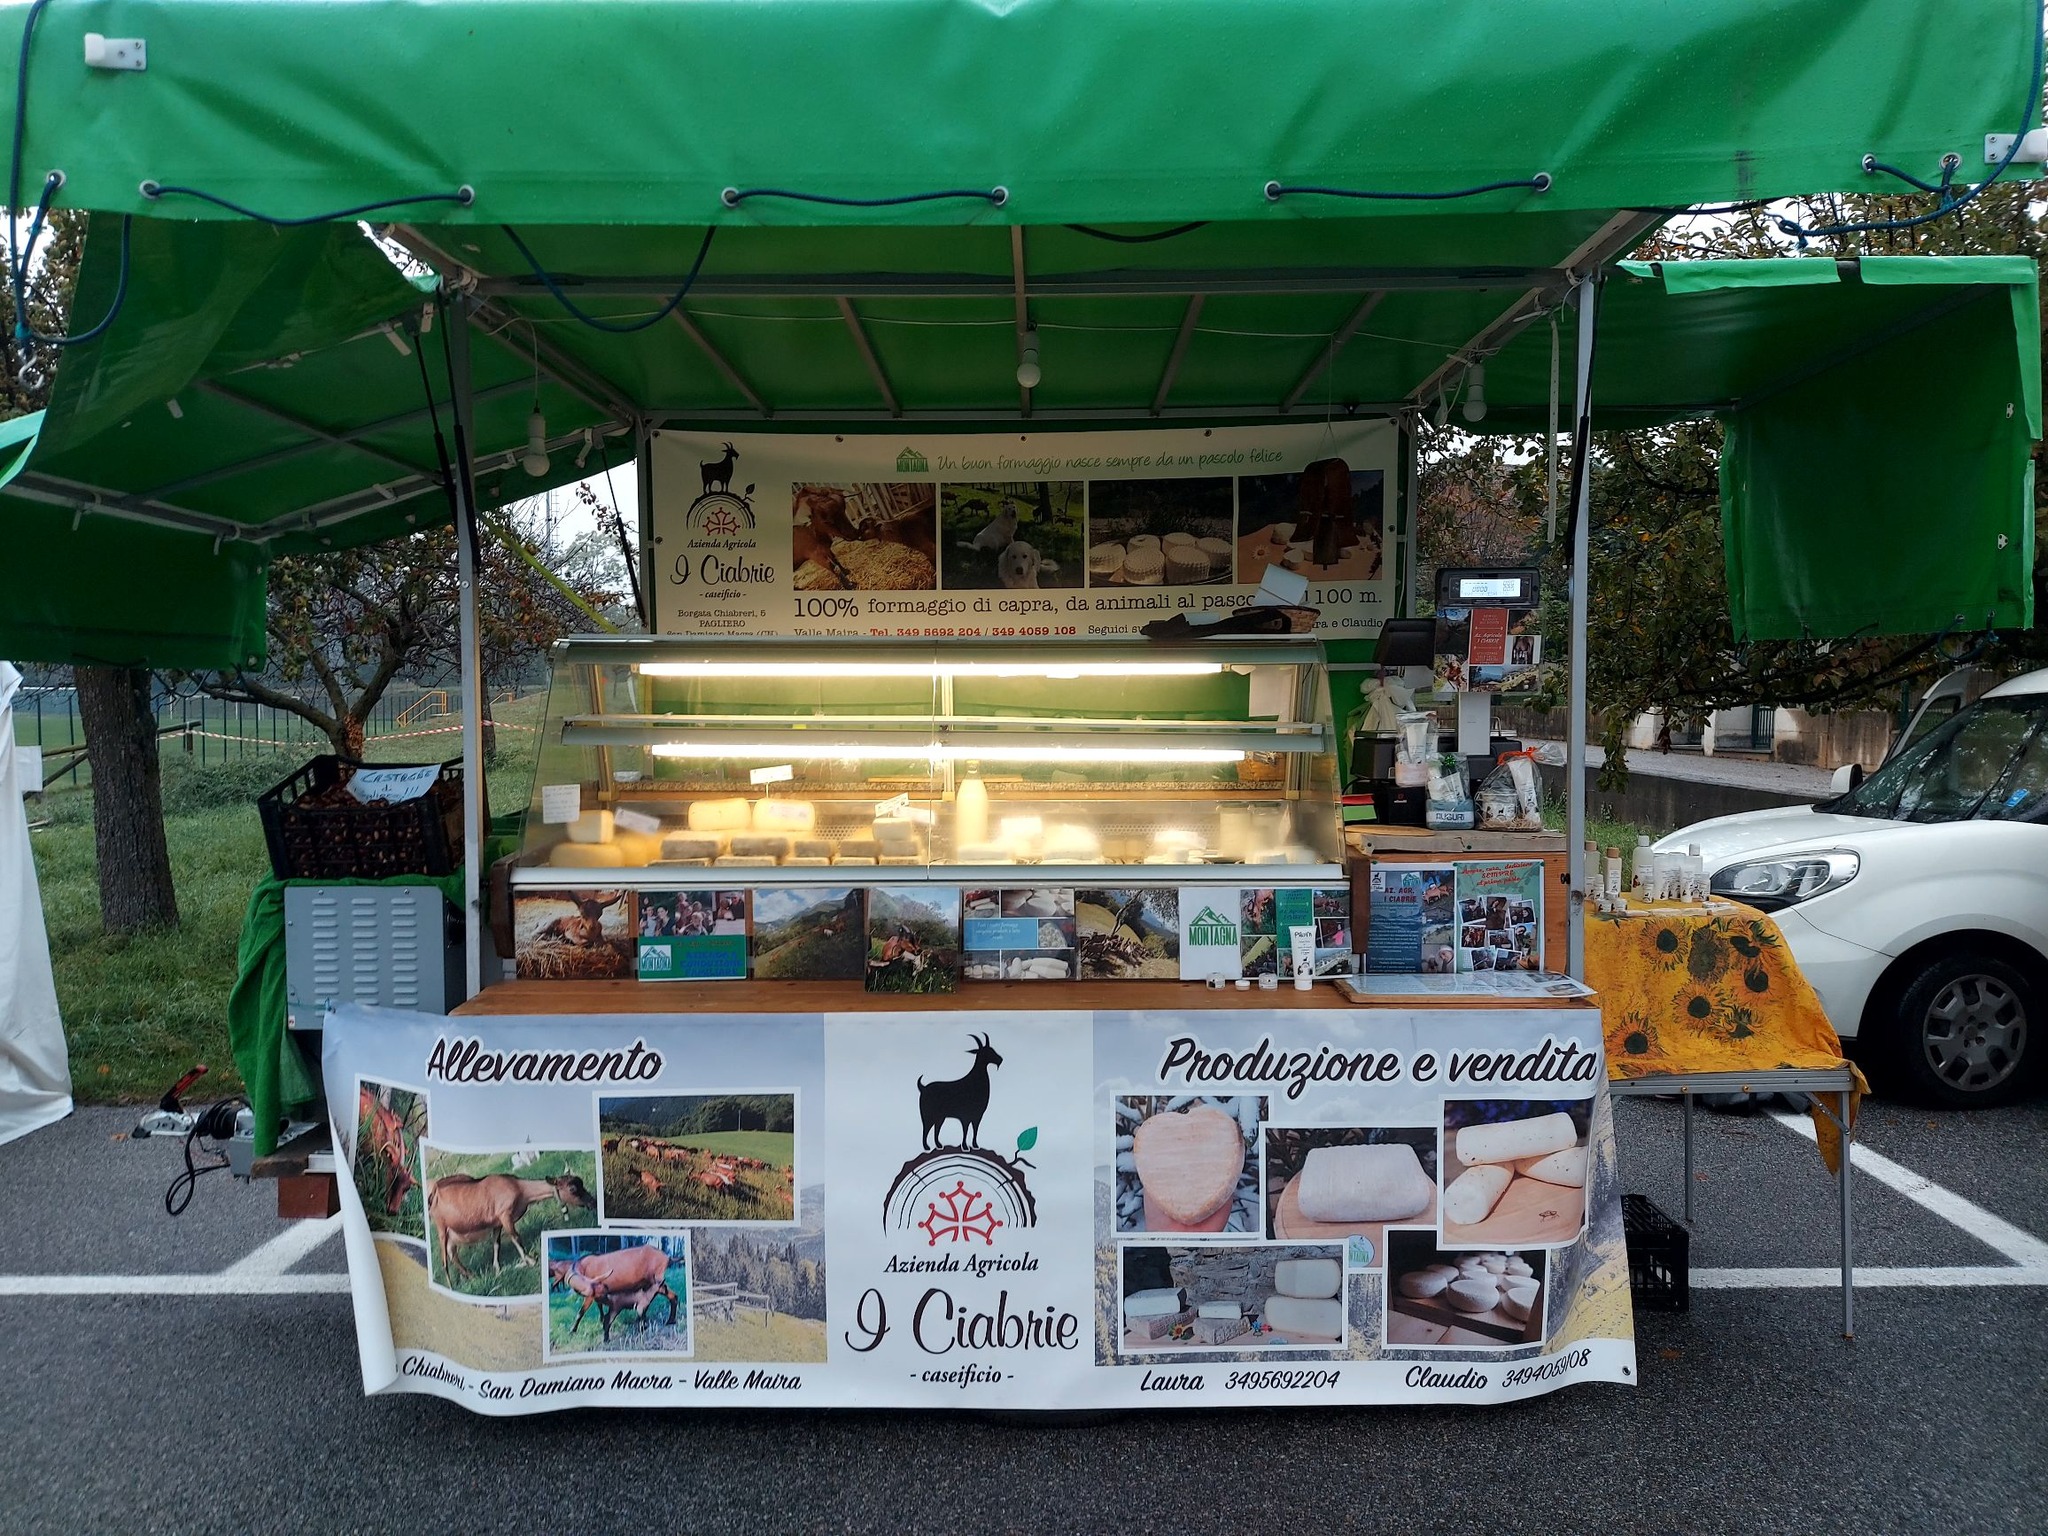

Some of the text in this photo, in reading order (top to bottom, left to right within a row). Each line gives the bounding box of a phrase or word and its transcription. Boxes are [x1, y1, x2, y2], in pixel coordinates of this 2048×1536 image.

[937, 448, 1283, 475] Un buon formaggio nasce sempre da un pascolo felice
[687, 538, 757, 551] Azienda Agricola
[700, 554, 775, 586] Ciabrie
[704, 588, 741, 601] caseificio
[794, 597, 860, 618] 100%
[867, 598, 967, 616] formaggio
[973, 597, 993, 612] di
[998, 598, 1059, 616] capra,
[1066, 596, 1090, 611] da
[1095, 593, 1170, 611] animali
[1177, 592, 1196, 608] al
[1201, 594, 1256, 611] pasco
[1359, 590, 1383, 604] m.
[678, 609, 712, 618] Borgata
[760, 609, 767, 617] 5
[699, 620, 746, 628] PAGLIERO
[1341, 617, 1384, 629] Claudio
[897, 628, 920, 637] 349
[924, 628, 955, 637] 5692
[958, 627, 982, 637] 204
[992, 626, 1016, 636] 349
[1018, 626, 1050, 636] 4059
[1054, 626, 1077, 635] 108
[1088, 624, 1129, 636] Seguici
[1435, 812, 1465, 821] AUGURI
[1188, 923, 1239, 947] MONTAGNA
[427, 1038, 663, 1083] Allevamento
[1160, 1037, 1598, 1099] Produzione e vendita
[883, 1252, 1039, 1278] Azienda Agricola
[844, 1288, 1080, 1355] I Ciabrie
[478, 1379, 514, 1400] San
[519, 1375, 606, 1399] Damiano
[610, 1369, 674, 1391] Macra
[693, 1369, 740, 1390] Valle
[742, 1370, 803, 1392] Maira
[922, 1363, 1002, 1389] caseificio
[1140, 1365, 1205, 1392] Laura
[1225, 1369, 1342, 1390] 3495692204
[1404, 1365, 1489, 1390] Claudio
